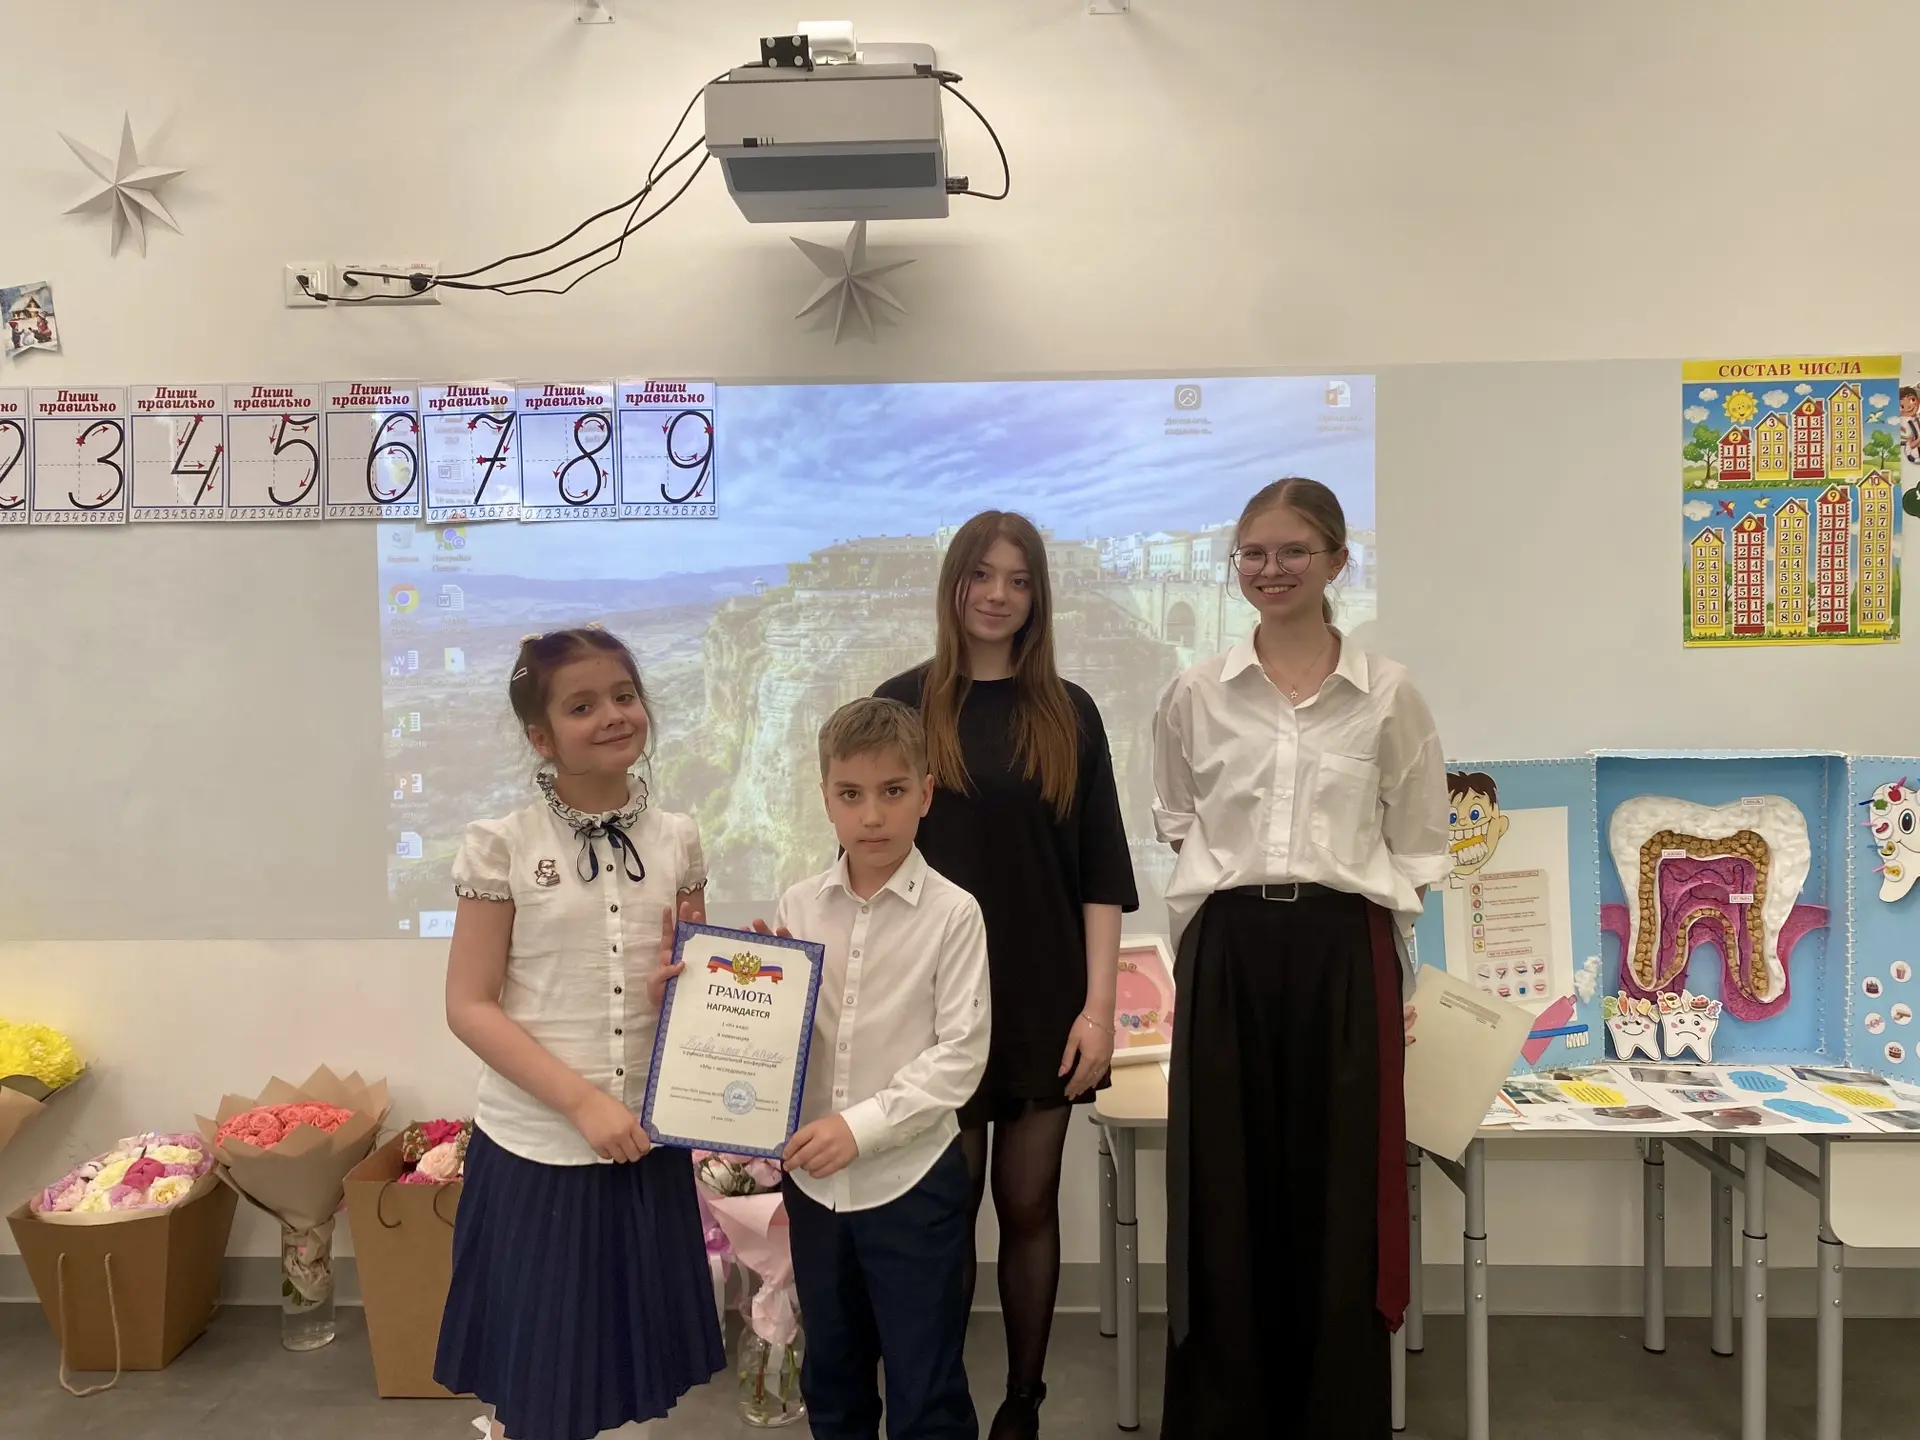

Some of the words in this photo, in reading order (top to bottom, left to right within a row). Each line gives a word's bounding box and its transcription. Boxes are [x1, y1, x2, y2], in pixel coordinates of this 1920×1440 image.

[1718, 363, 1790, 378] СОСТАВ
[1799, 362, 1862, 375] ЧИСЛА
[155, 387, 197, 398] Пиши
[251, 386, 293, 398] Пиши
[350, 384, 392, 395] Пиши
[446, 386, 490, 397] Пиши
[543, 385, 586, 396] Пиши
[644, 381, 687, 393] Пиши
[1842, 388, 1848, 398] 5
[57, 390, 98, 402] Пиши
[332, 395, 410, 408] правильно
[626, 393, 705, 406] правильно
[39, 403, 116, 415] правильно
[138, 399, 215, 411] правильно
[234, 398, 311, 411] правильно
[428, 396, 508, 410] правильно
[526, 396, 604, 410] правильно
[1806, 403, 1812, 413] 4
[1769, 418, 1775, 427] 3
[1732, 432, 1738, 441] 2
[171, 414, 224, 506] 4
[268, 414, 319, 506] 5
[367, 412, 417, 504] 6
[468, 412, 516, 504] 7
[559, 412, 612, 506] 8
[660, 411, 713, 503] 9
[68, 420, 124, 510] 3
[1870, 476, 1879, 486] 10
[1830, 492, 1836, 501] 9
[1788, 505, 1795, 514] 8
[1746, 520, 1753, 529] 7
[1704, 534, 1710, 543] 6
[708, 984, 772, 1005] ГРАМОТА
[706, 1002, 770, 1019] НАГРАЖДАЕТСЯ
